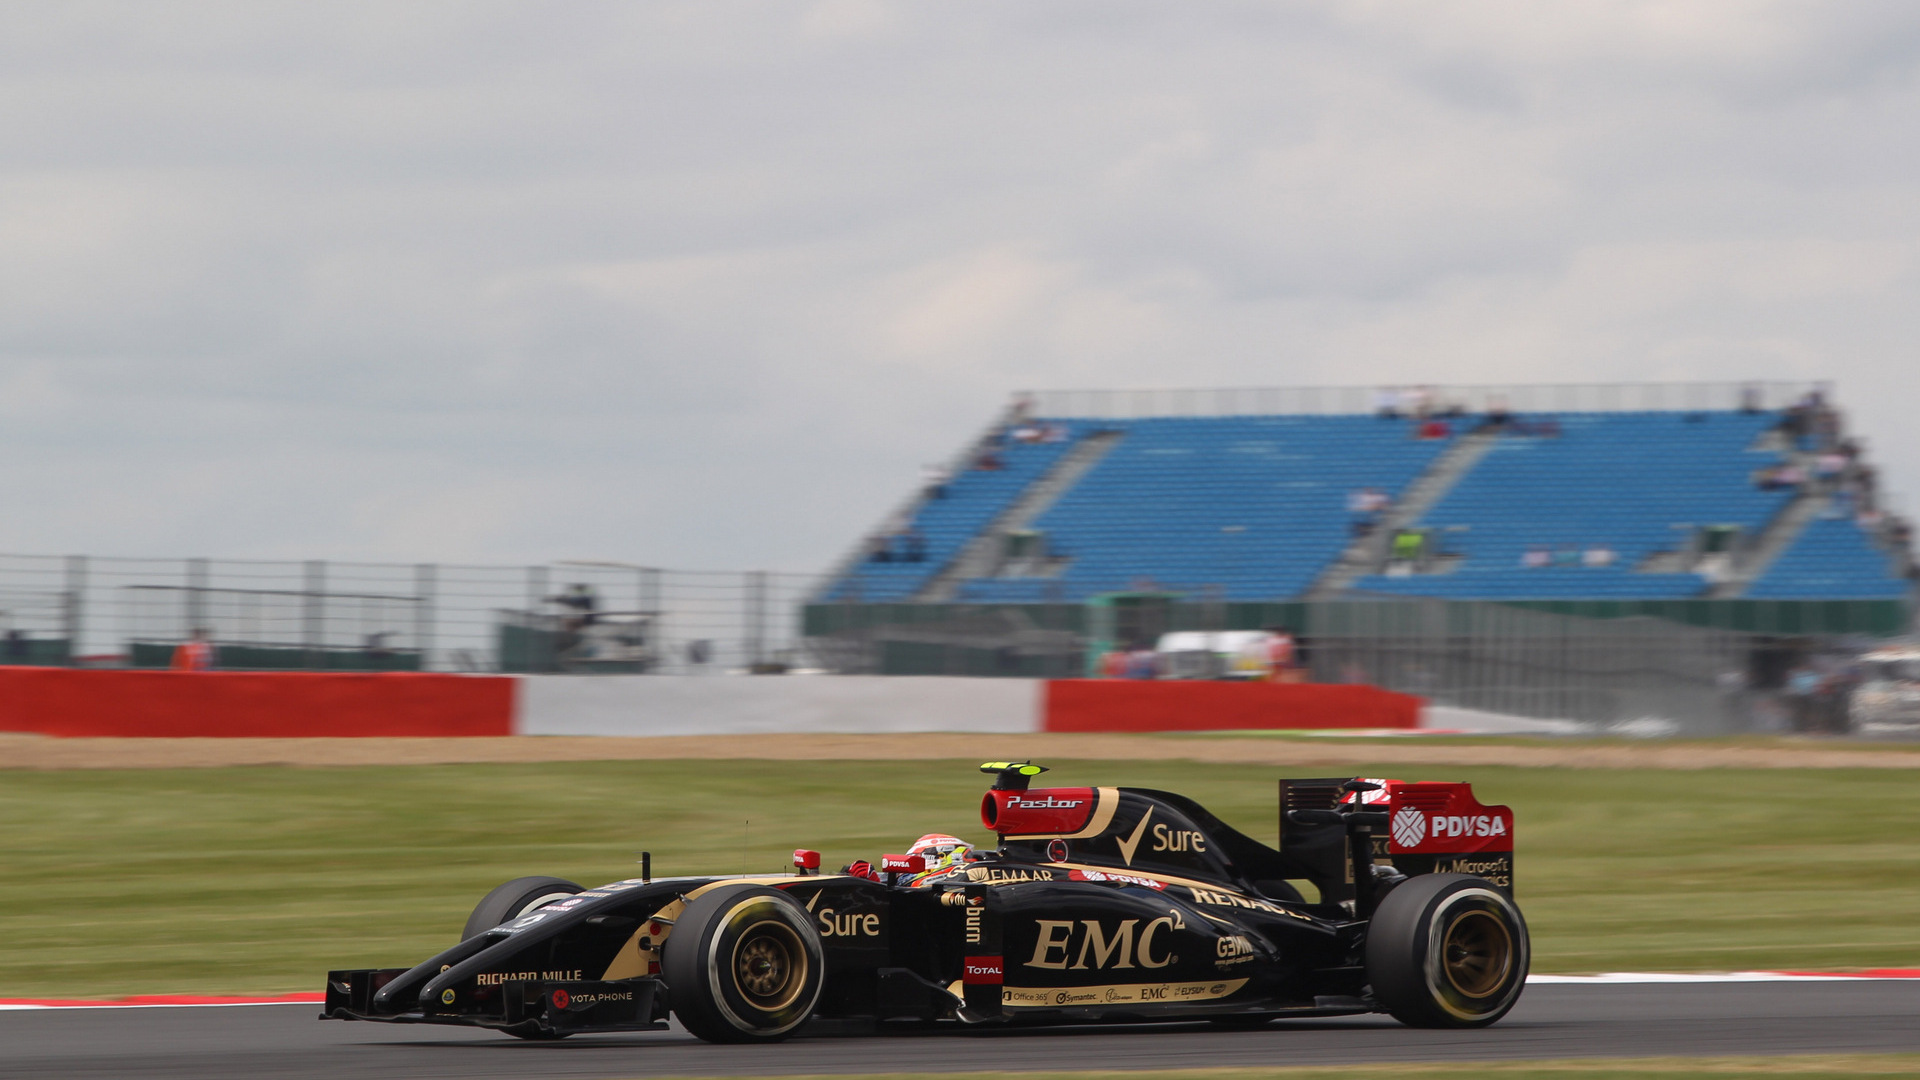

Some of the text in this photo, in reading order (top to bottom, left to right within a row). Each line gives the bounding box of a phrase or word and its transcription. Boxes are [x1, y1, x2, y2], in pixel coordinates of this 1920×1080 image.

[1007, 796, 1083, 809] Pastor
[1431, 815, 1507, 838] PDVSA
[1153, 824, 1206, 852] Sure
[889, 860, 910, 868] PDVSA
[1452, 858, 1509, 874] Microsoft
[990, 869, 1054, 882] EMAAR
[1107, 872, 1162, 888] PDVSA
[819, 908, 880, 937] Sure
[966, 906, 985, 943] burn
[477, 970, 582, 986] RICHARD MILLE
[570, 992, 633, 1003] YOTA PHONE
[1013, 992, 1048, 1001] Office 365
[1066, 993, 1097, 1002] Symantec
